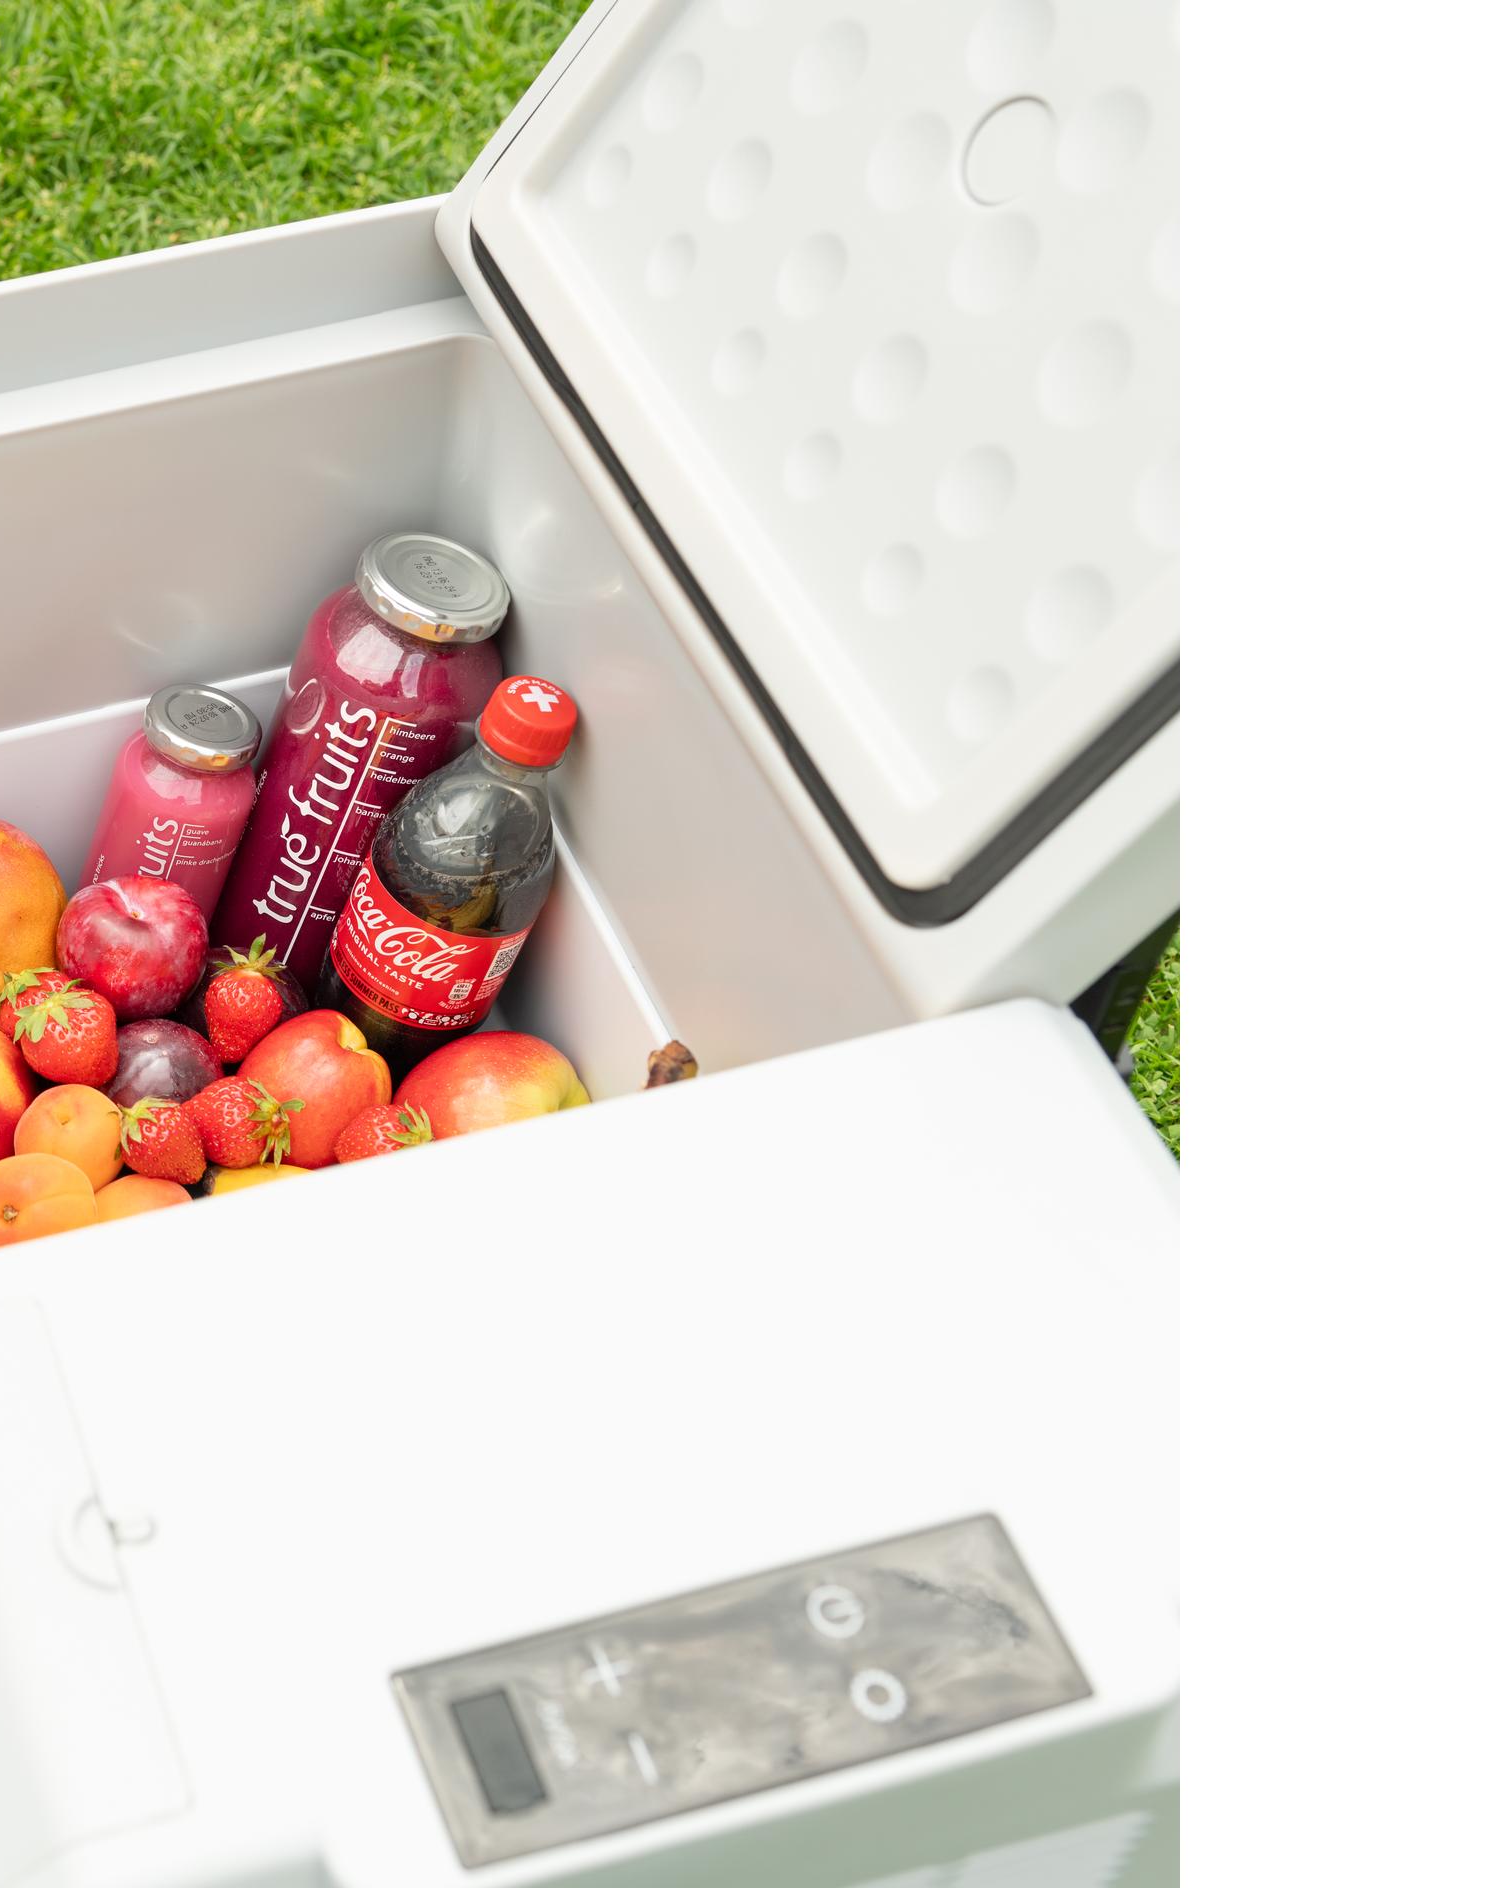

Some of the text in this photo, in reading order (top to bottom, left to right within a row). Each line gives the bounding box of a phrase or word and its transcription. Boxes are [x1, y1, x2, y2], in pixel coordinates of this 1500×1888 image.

[507, 679, 563, 696] SWISS MADE
[389, 726, 436, 741] himbeere
[379, 750, 415, 764] orange
[252, 700, 377, 924] true fruits
[186, 828, 210, 836] guave
[182, 839, 222, 848] guanábana
[176, 858, 197, 867] pinke
[310, 911, 335, 922] apfel
[350, 867, 480, 982] Coca-Cola
[346, 917, 380, 967] ORIGINAL
[384, 965, 425, 991] TASTE
[367, 970, 400, 996] Refreshing
[350, 972, 380, 1002] SUMMER
[378, 996, 400, 1014] PASS
